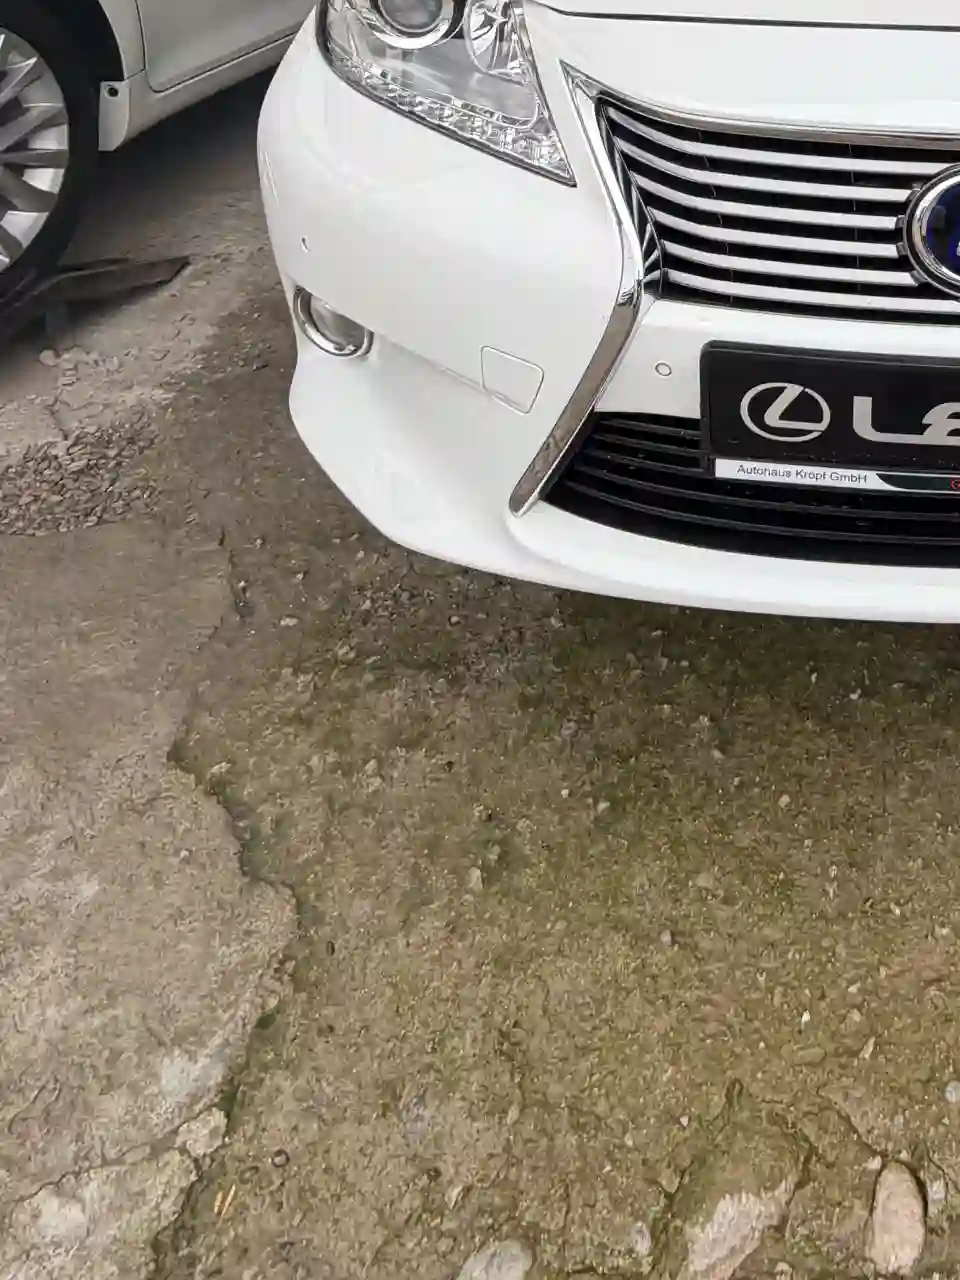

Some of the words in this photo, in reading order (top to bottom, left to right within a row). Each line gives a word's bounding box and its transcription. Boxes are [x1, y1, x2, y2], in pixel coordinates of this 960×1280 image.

[736, 463, 792, 478] Autohaus
[795, 467, 828, 481] Kropf
[829, 470, 868, 484] GmbH
